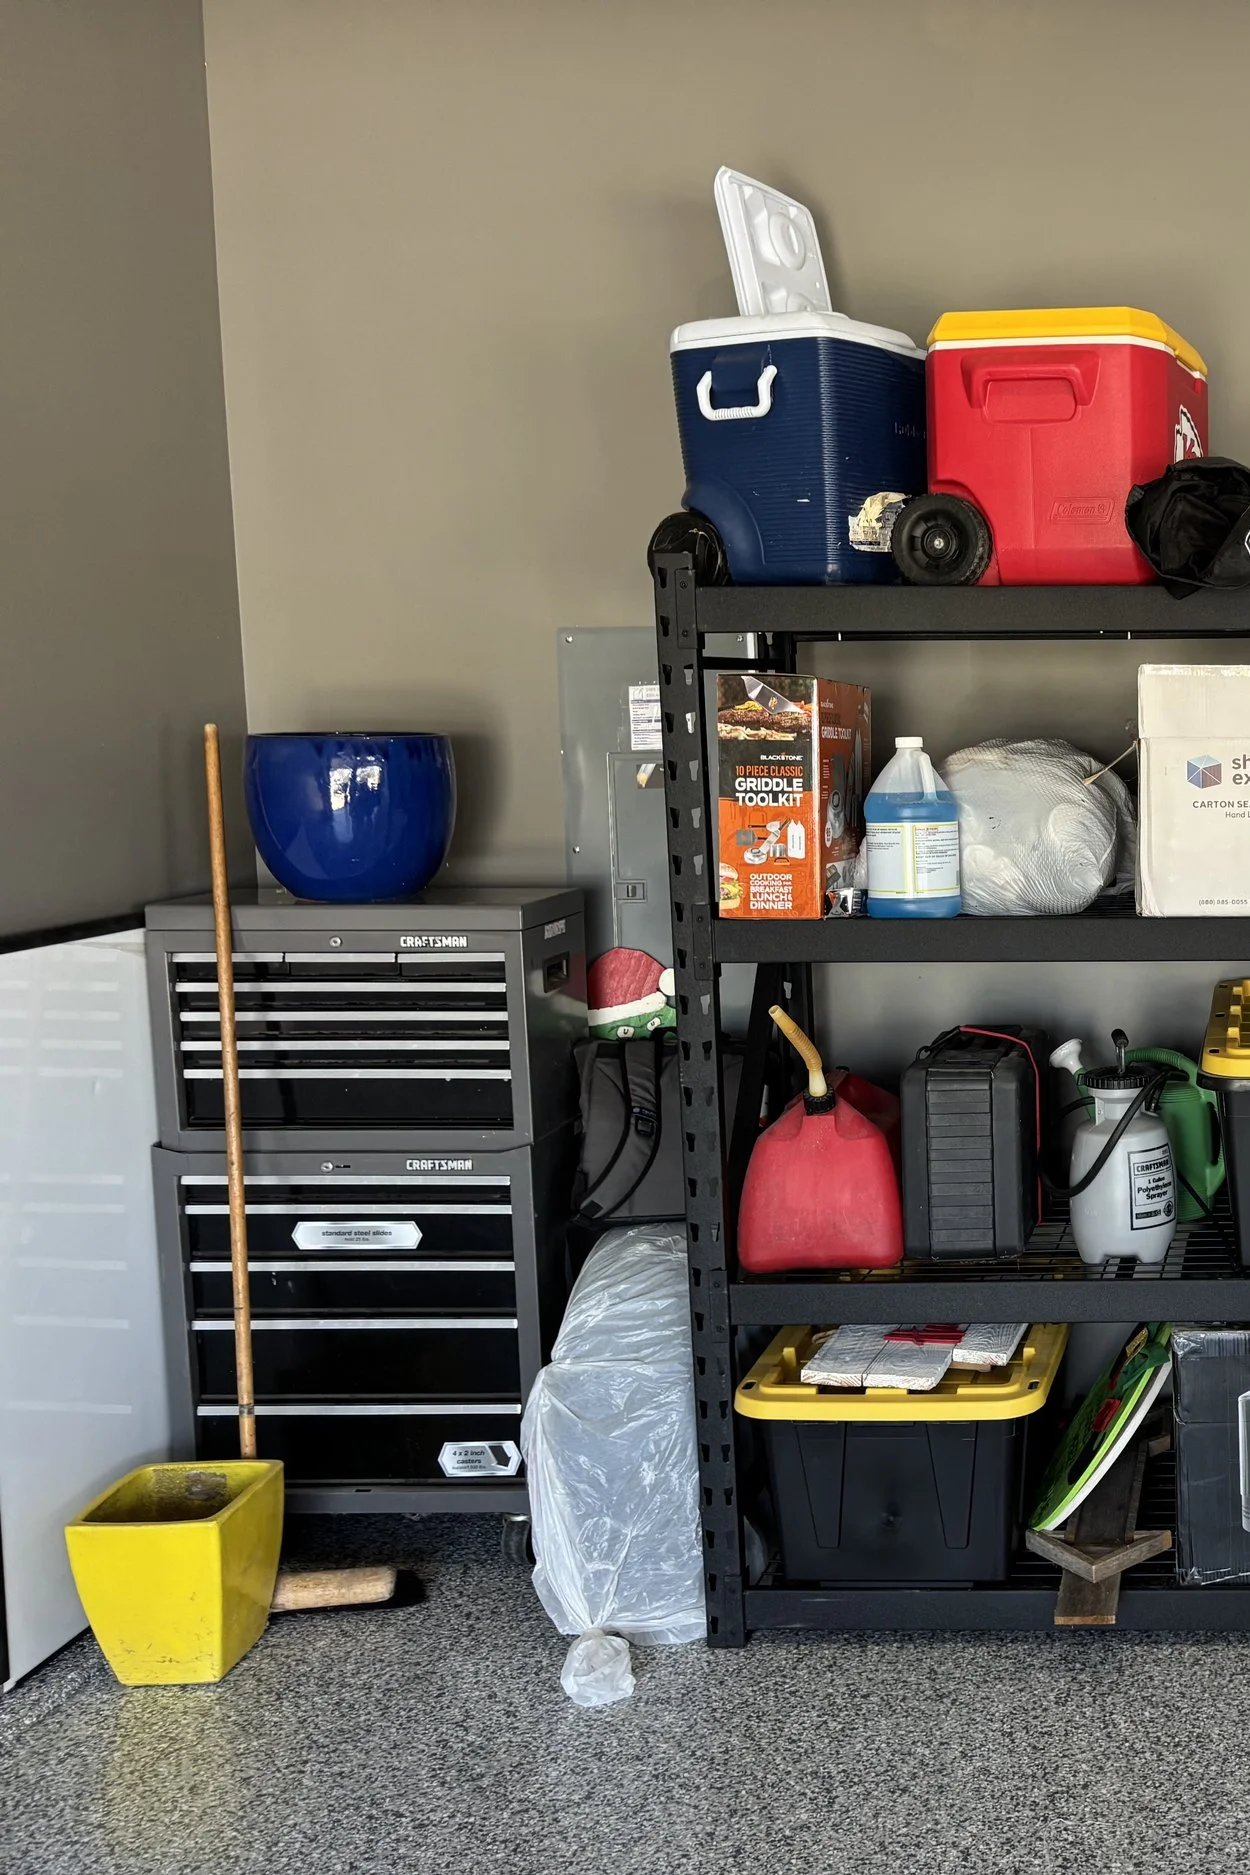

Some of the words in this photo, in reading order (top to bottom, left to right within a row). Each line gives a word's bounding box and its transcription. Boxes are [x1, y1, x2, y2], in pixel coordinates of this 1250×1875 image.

[736, 765, 745, 776] 10
[746, 765, 769, 776] PIECE
[770, 765, 803, 777] CLASSIC
[735, 777, 803, 791] GRIDDLE
[735, 792, 803, 806] TOOLKIT
[750, 893, 788, 901] LUNCH
[750, 901, 793, 909] DINNER
[400, 936, 468, 948] CRAFTSMAN
[406, 1159, 473, 1171] CRAFTSMAN
[1136, 1159, 1169, 1172] CRAFTSMAN
[1137, 1181, 1172, 1194] Polyethylene
[1146, 1190, 1168, 1200] Sprayer
